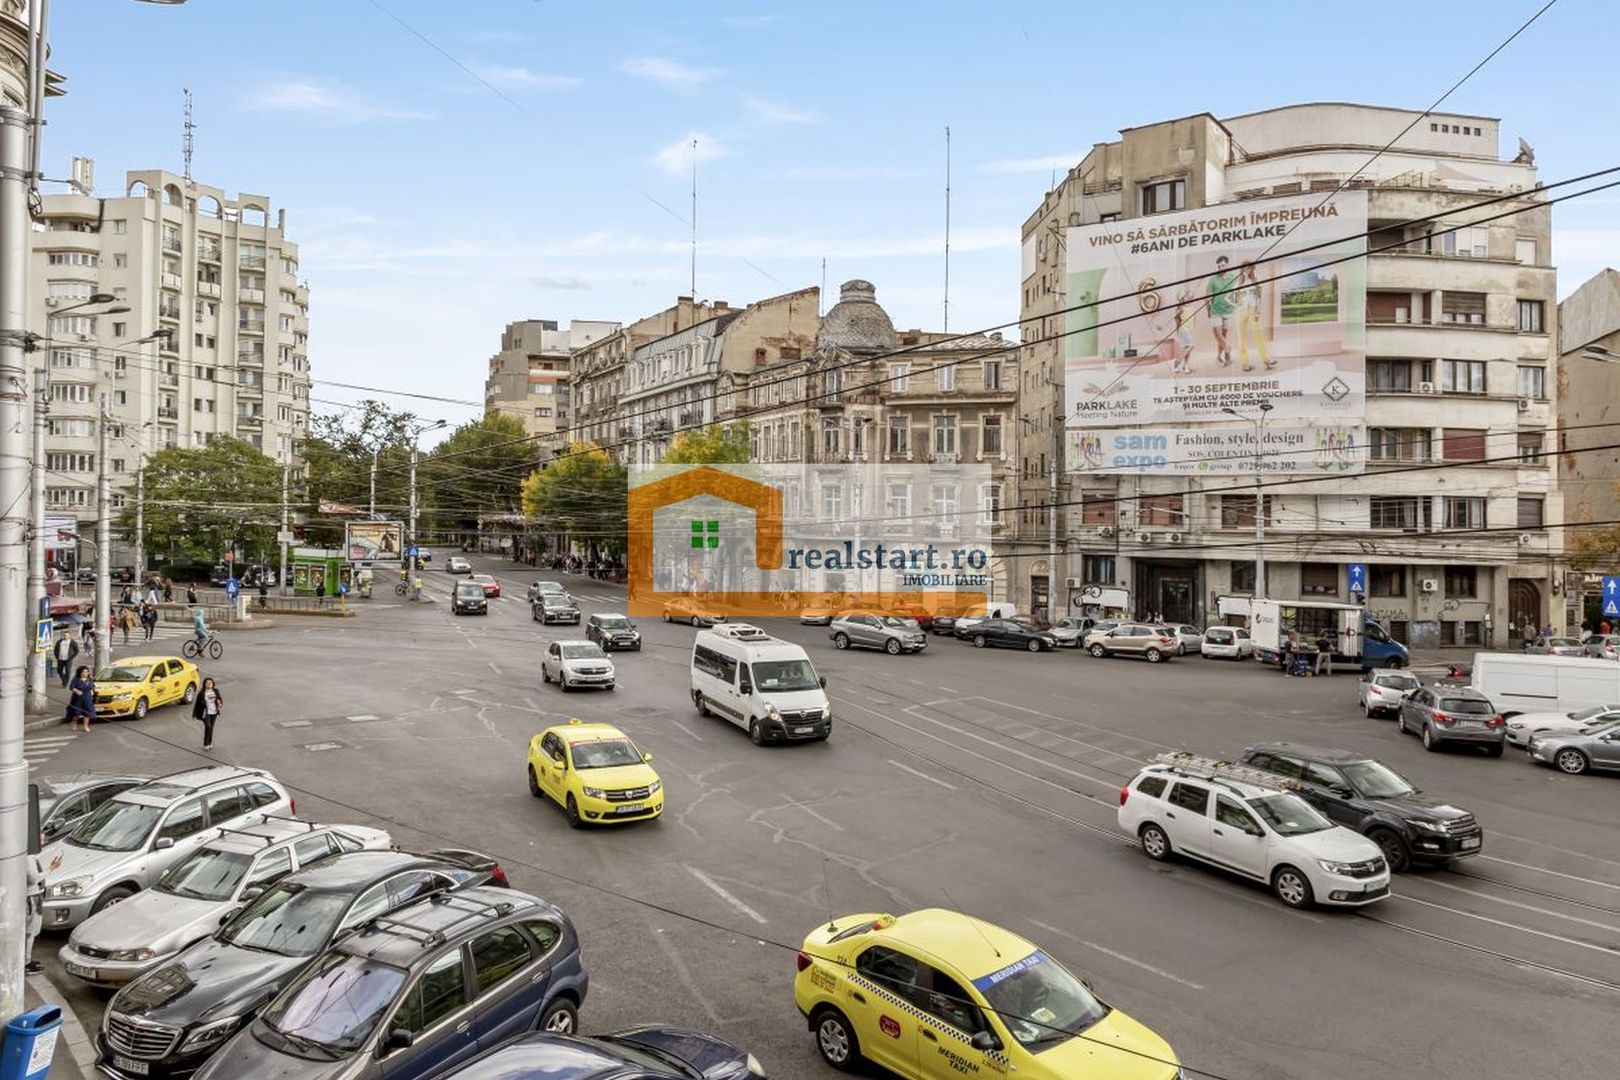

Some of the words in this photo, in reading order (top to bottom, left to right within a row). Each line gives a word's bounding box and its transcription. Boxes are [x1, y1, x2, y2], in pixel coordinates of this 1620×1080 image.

[1089, 233, 1123, 247] VINO
[1127, 227, 1145, 242] SĂ
[1149, 215, 1246, 239] SĂRBĂTORIM
[1250, 202, 1338, 225] ÎMPREUNĂ
[1131, 239, 1174, 254] #6ANI
[1178, 235, 1198, 249] DE
[1201, 224, 1286, 244] PARKLAKE
[1204, 380, 1280, 393] SEPTEMBRIE
[1076, 400, 1138, 411] PARKLAKE
[1113, 434, 1168, 450] sam
[1175, 434, 1225, 446] Fashion,
[1263, 431, 1304, 446] design
[1113, 455, 1168, 471] expo
[990, 962, 1025, 984] MERIDIAN
[1022, 954, 1040, 968] TAXI
[938, 1046, 980, 1073] MERIDIAN
[950, 1060, 968, 1075] TAXI
